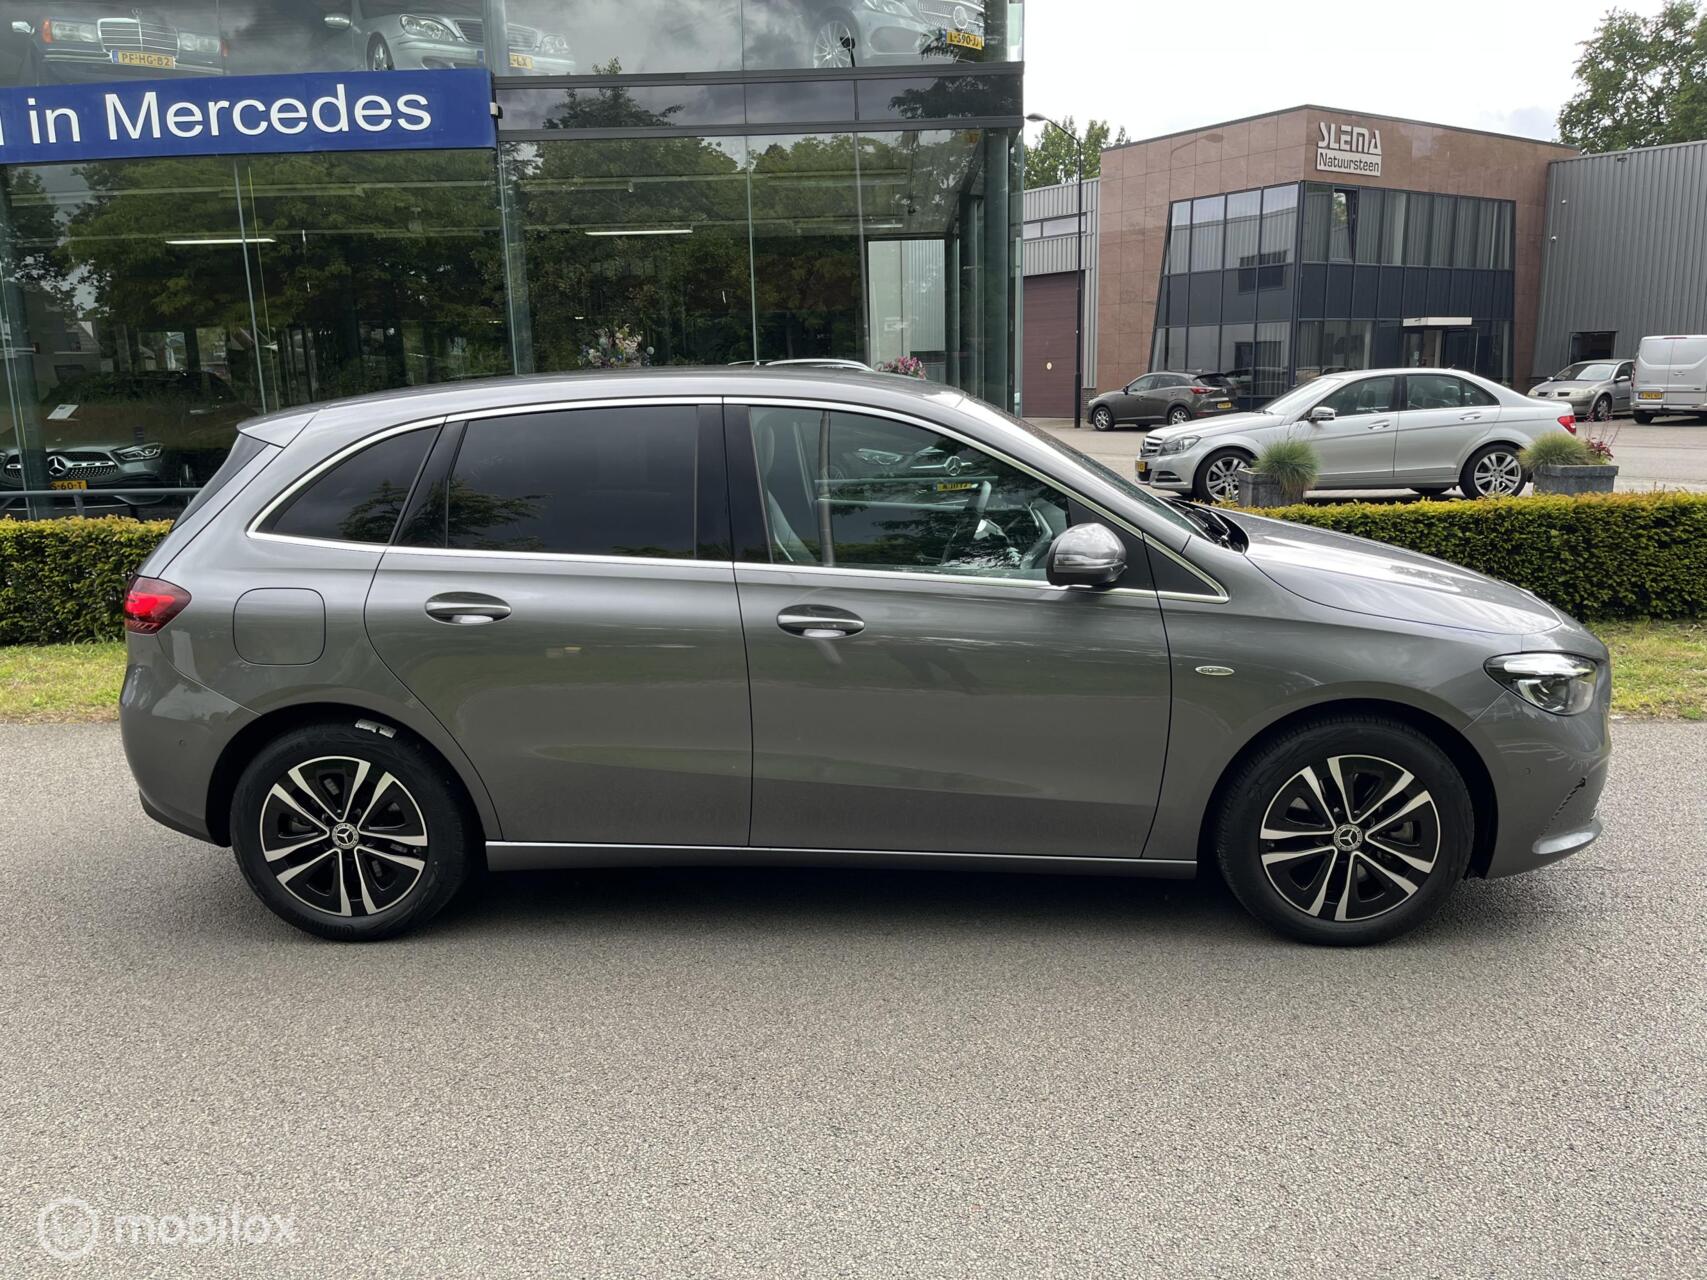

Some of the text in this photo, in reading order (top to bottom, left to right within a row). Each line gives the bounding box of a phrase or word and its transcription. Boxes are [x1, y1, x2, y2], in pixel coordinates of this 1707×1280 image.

[27, 97, 81, 145] in
[104, 83, 433, 141] Mercedes
[1318, 121, 1382, 155] SLEMA
[1319, 152, 1380, 173] Natuursteen
